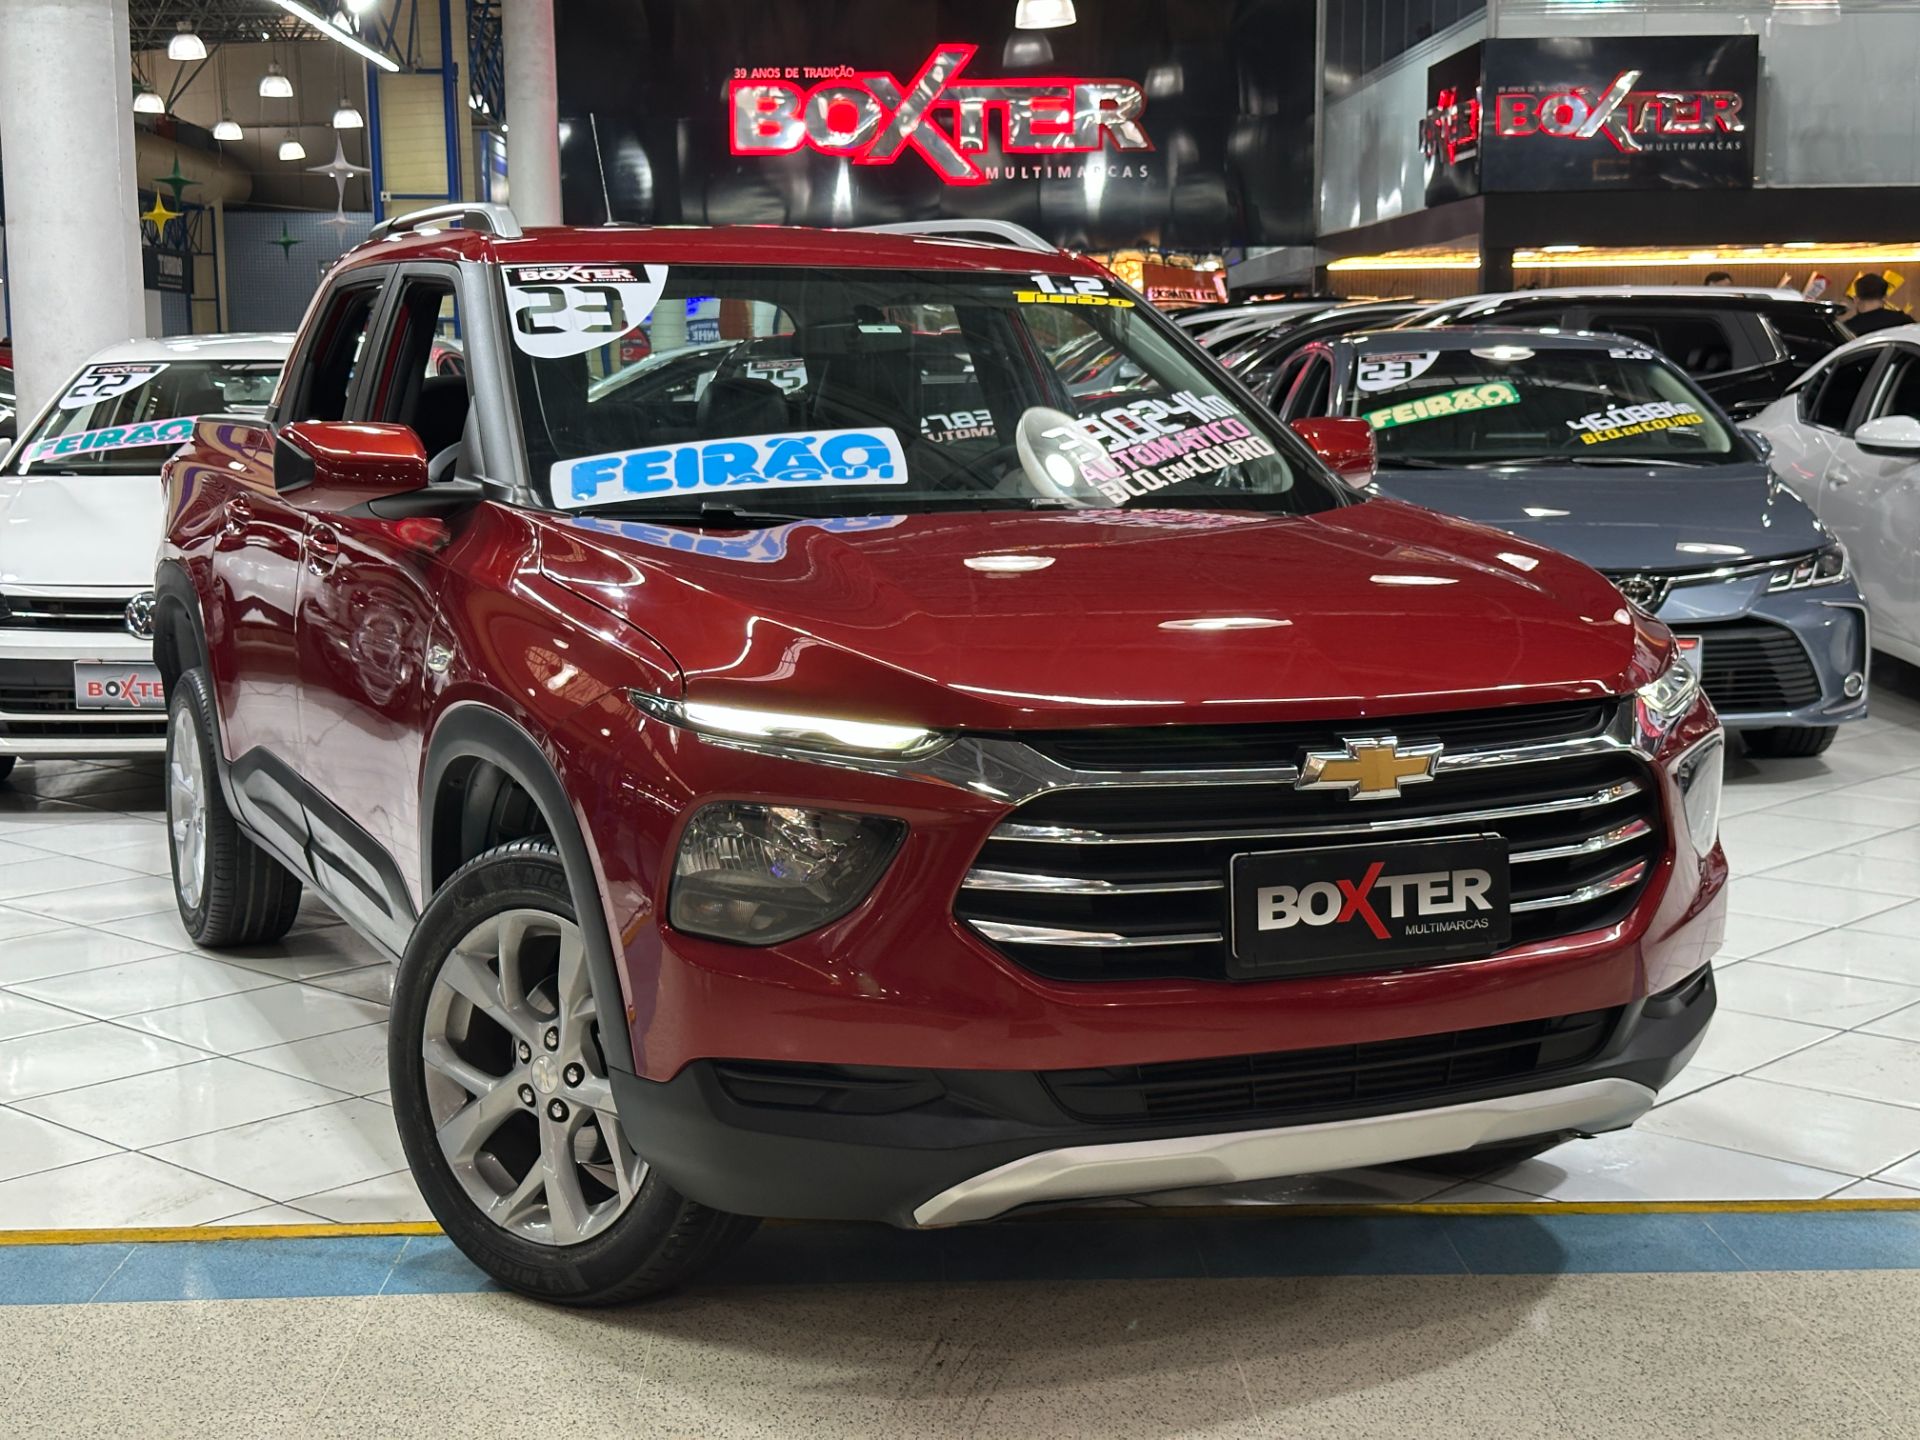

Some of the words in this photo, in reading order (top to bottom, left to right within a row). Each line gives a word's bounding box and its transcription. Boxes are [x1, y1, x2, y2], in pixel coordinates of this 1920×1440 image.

[734, 68, 747, 79] 39
[751, 68, 781, 79] ANOS
[785, 68, 799, 79] DE
[803, 65, 854, 79] TRADIÇÃO
[729, 43, 1156, 185] BOXTER
[1496, 70, 1745, 153] BOXTER
[1644, 141, 1742, 152] MULTIMARCAS
[985, 165, 1149, 180] MULTIMARCAS
[518, 265, 633, 283] BOXTER
[1030, 274, 1109, 296] 1.2
[515, 285, 629, 335] 23
[1608, 348, 1653, 360] 2.0
[1361, 361, 1412, 381] 23
[67, 374, 132, 398] 22
[1370, 383, 1512, 428] FEIRÃO
[30, 419, 194, 458] FEIRÃO
[1183, 436, 1276, 474] COURO
[571, 433, 892, 501] FEIRÃO
[726, 464, 895, 485] AQUI
[1257, 862, 1494, 940] BOXTER
[1405, 917, 1489, 936] MULTIMARCAS
